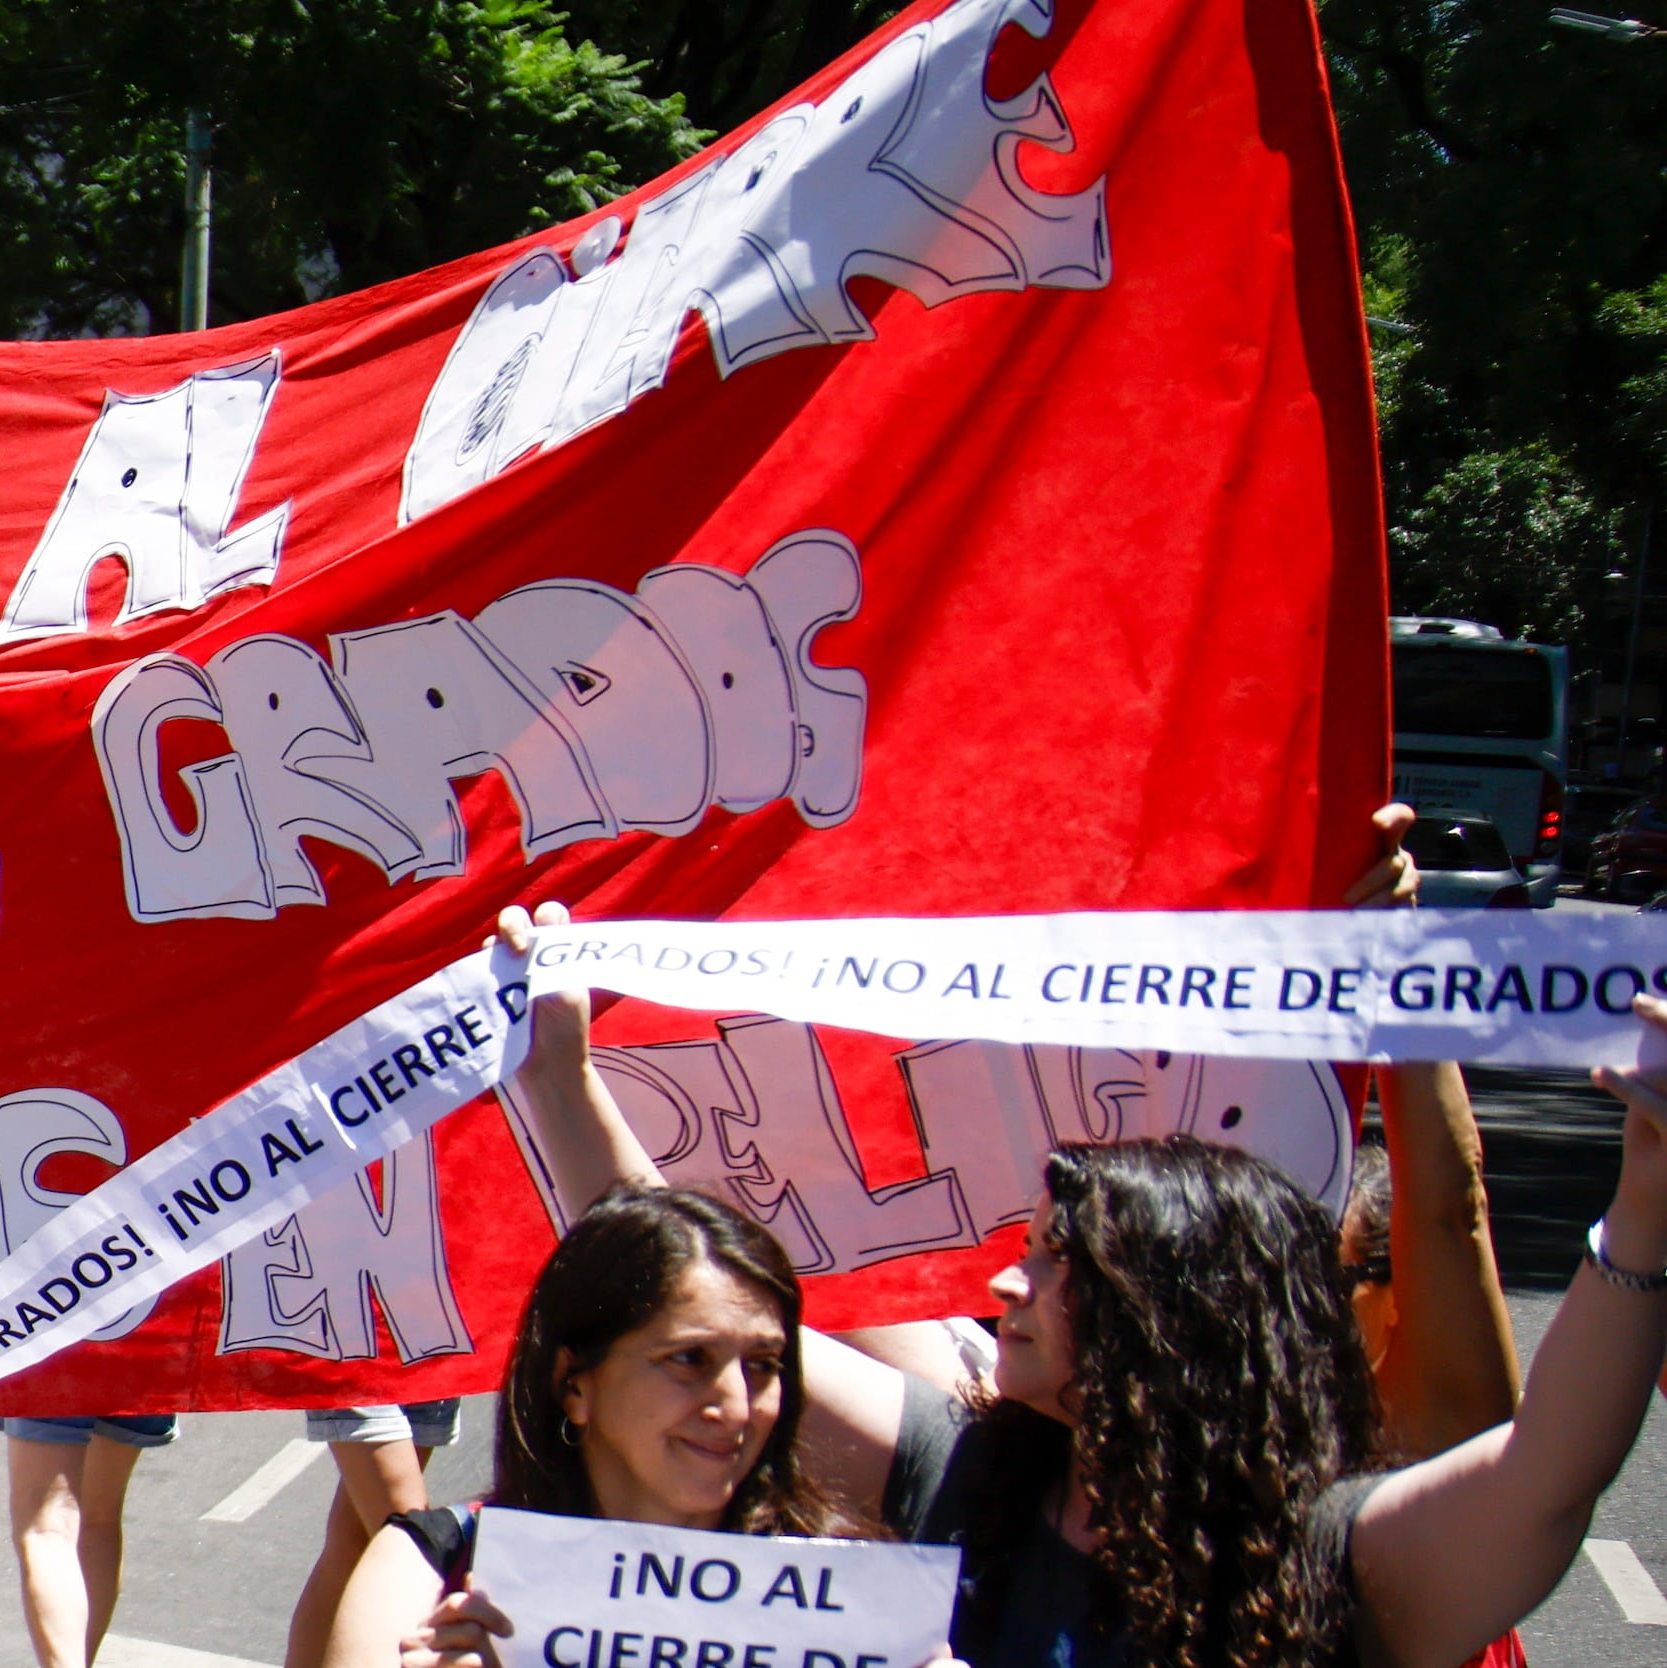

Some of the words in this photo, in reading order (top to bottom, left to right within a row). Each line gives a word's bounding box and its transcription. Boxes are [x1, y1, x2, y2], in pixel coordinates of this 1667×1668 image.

[535, 940, 789, 980] GRADOS!
[810, 956, 927, 994] ¡NO
[942, 963, 1012, 1001] AL
[1040, 963, 1257, 1010] CIERRE
[1277, 965, 1364, 1013] DE
[157, 1158, 253, 1241] ¡NO
[261, 1117, 324, 1177] AL
[330, 1004, 493, 1128] CIERRE
[495, 979, 530, 1026] D
[186, 1112, 476, 1366] EN
[608, 1552, 742, 1603] ¡NO
[765, 1562, 845, 1613] AL
